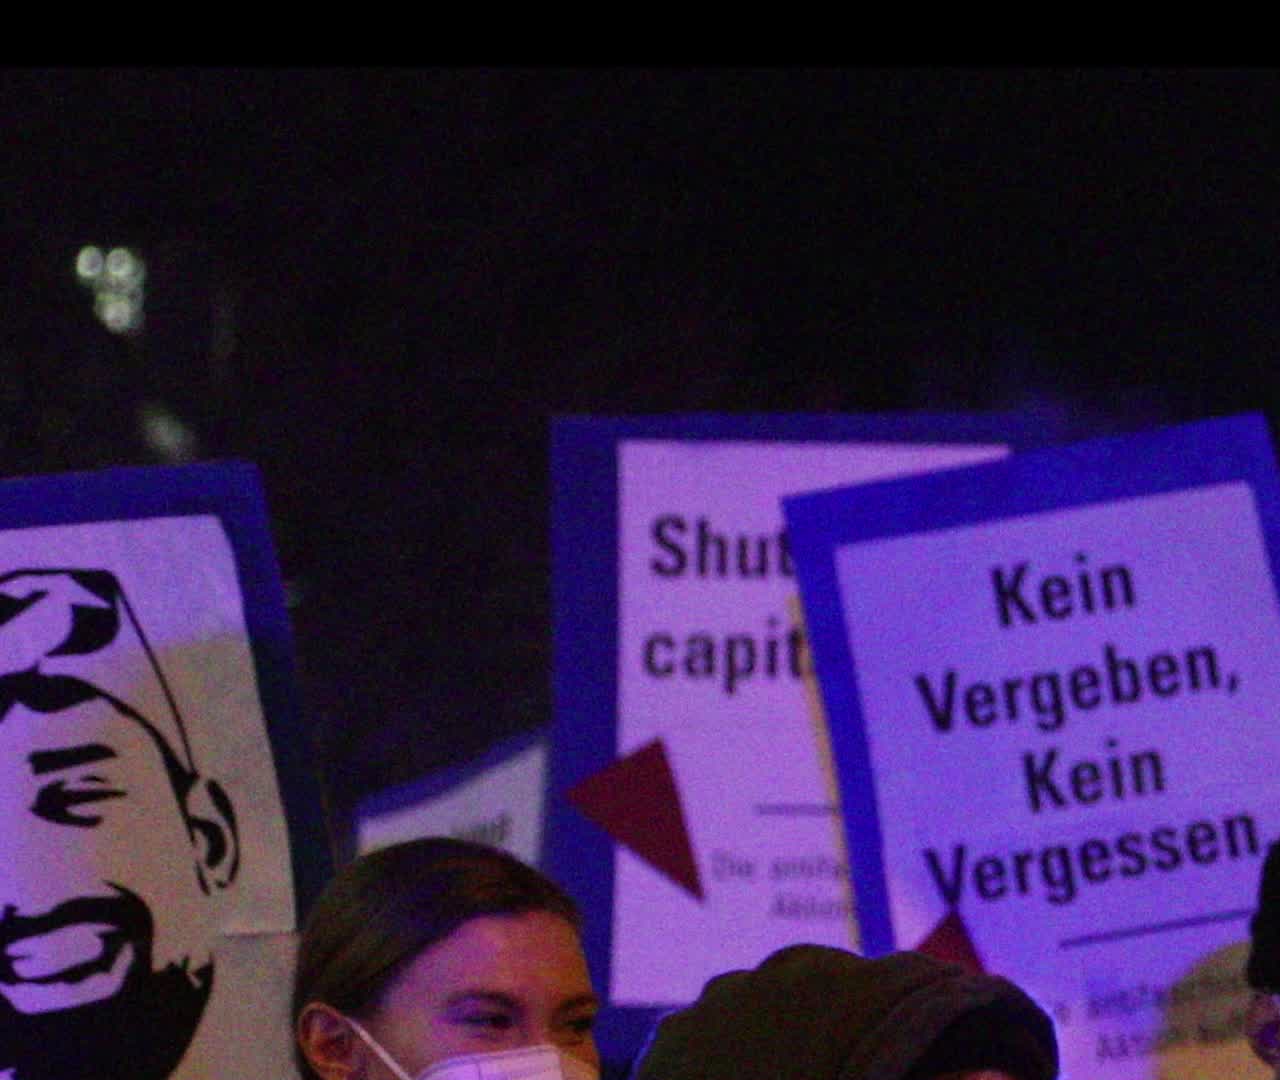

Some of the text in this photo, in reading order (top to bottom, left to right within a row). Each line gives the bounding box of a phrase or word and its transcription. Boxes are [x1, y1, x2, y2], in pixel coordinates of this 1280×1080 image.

[991, 553, 1136, 630] Kein
[914, 642, 1242, 734] Vergeben,
[1022, 738, 1166, 814] Kein
